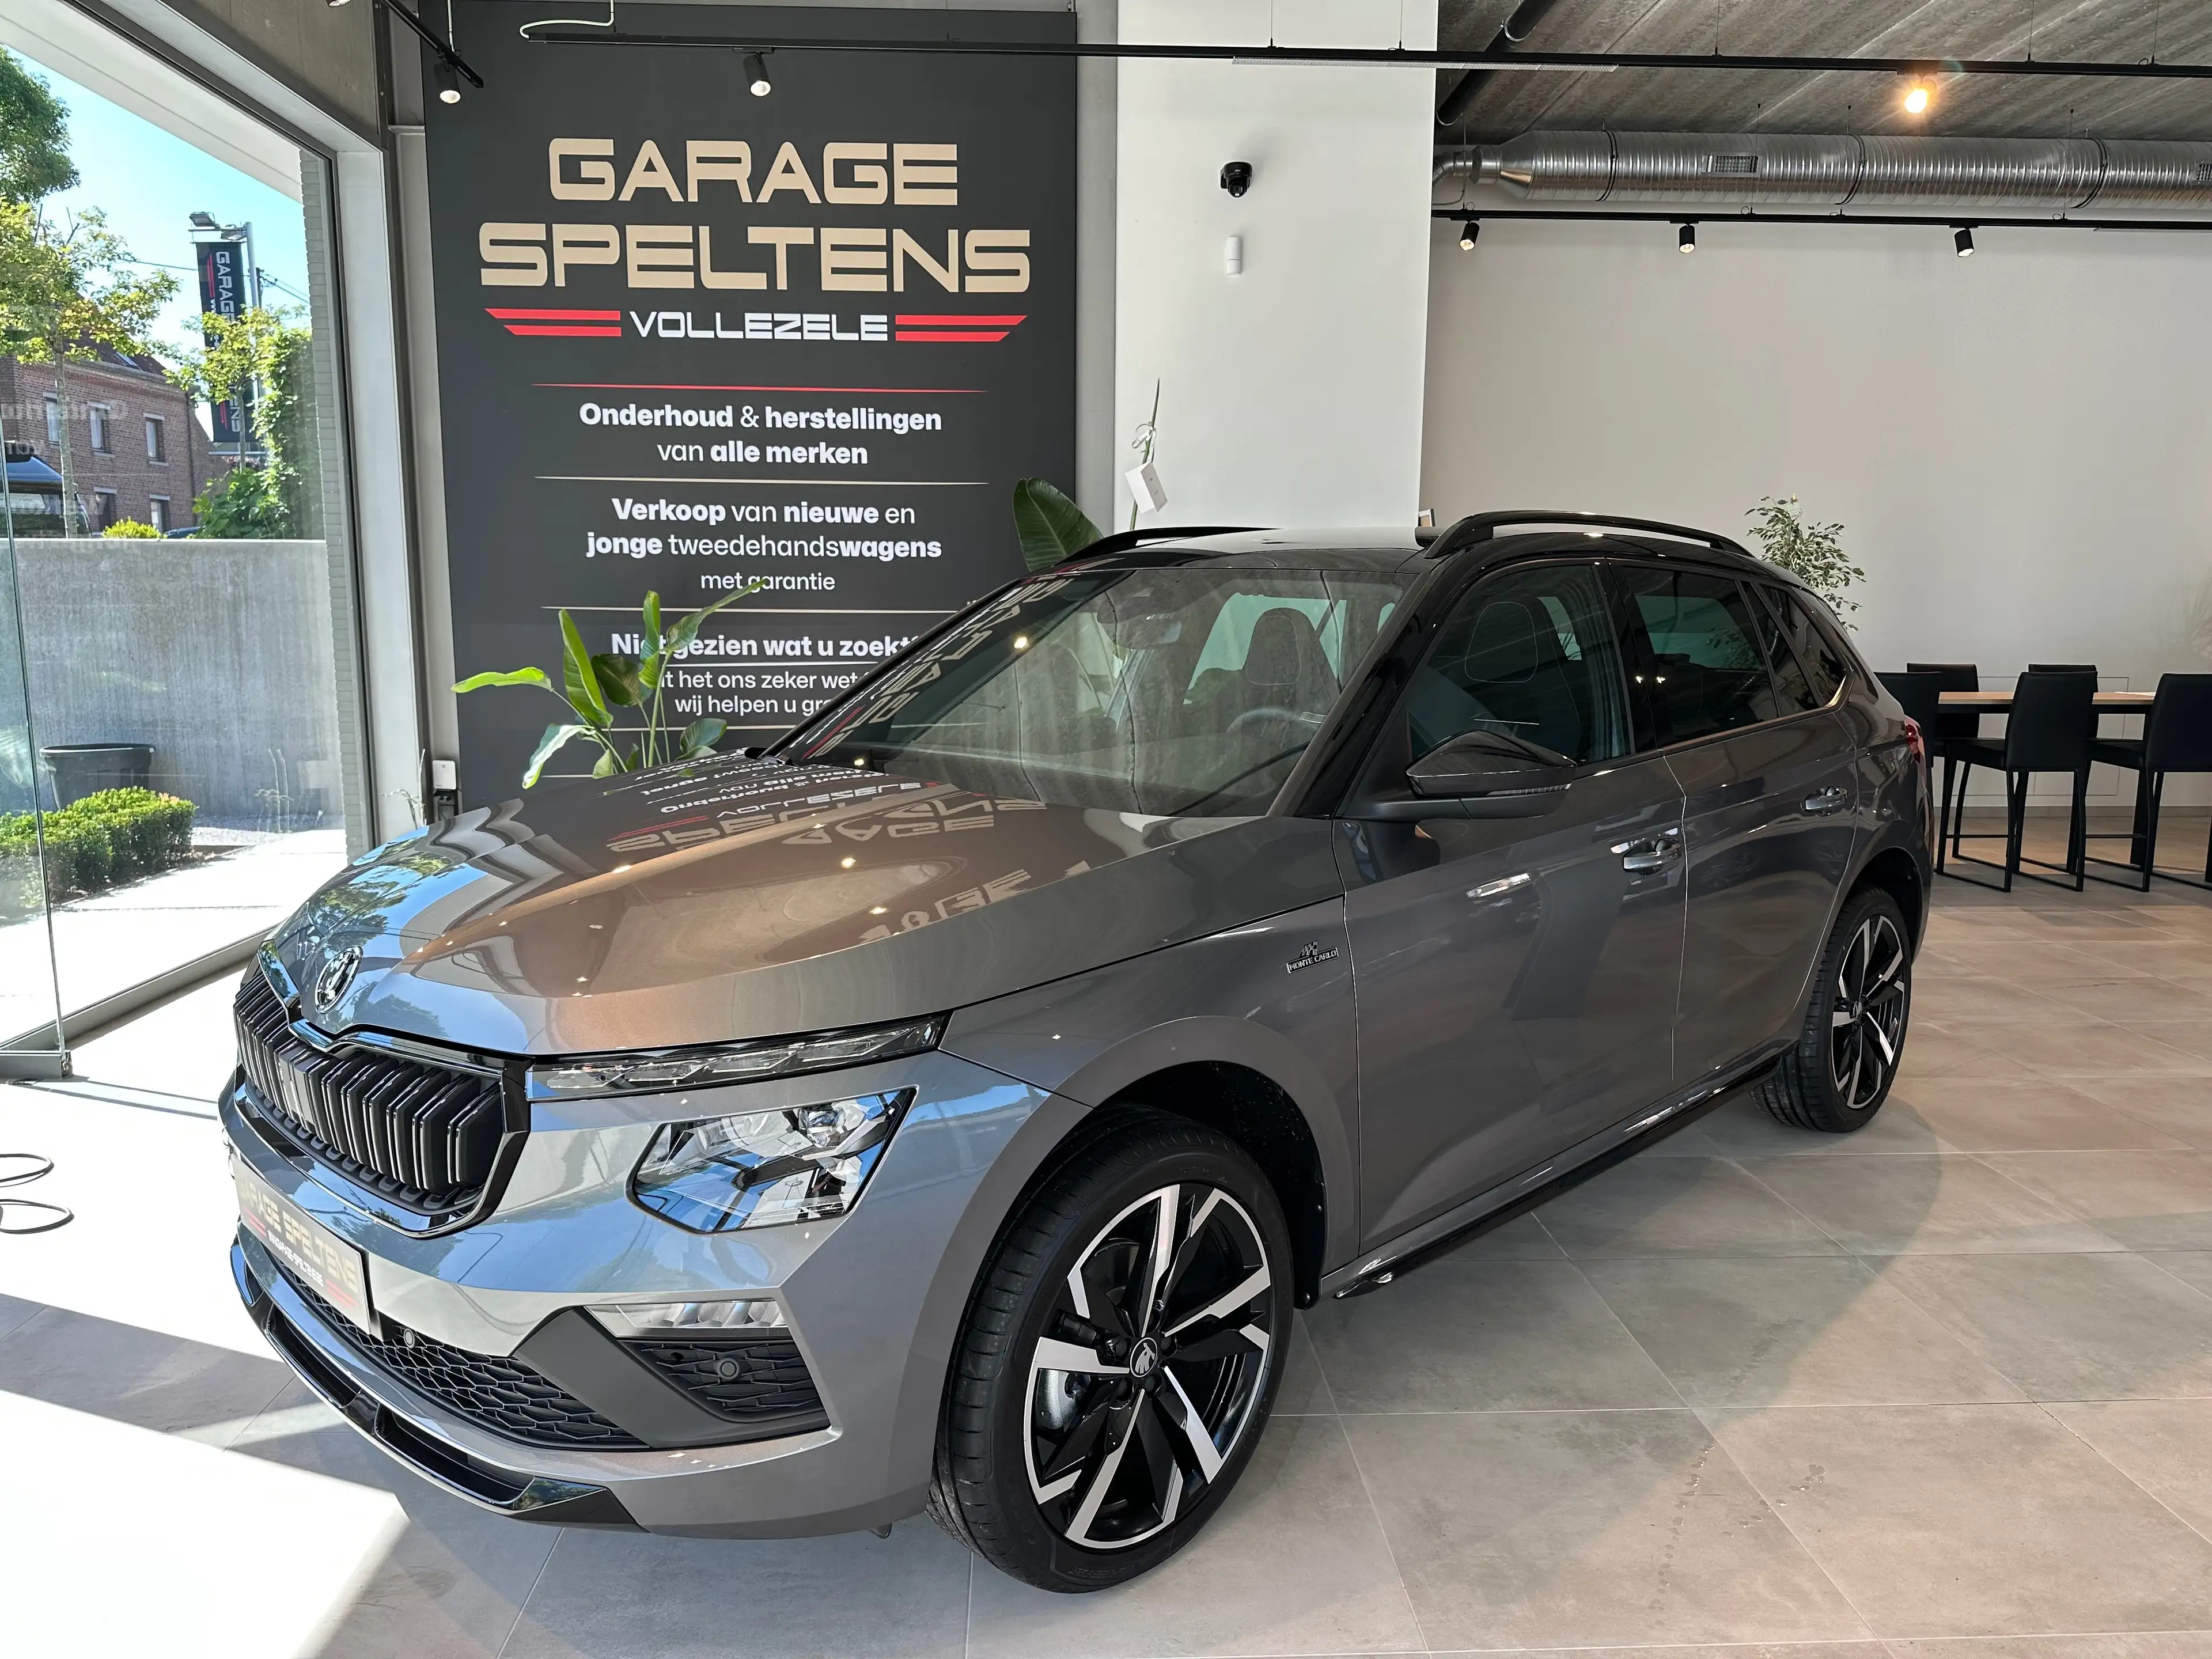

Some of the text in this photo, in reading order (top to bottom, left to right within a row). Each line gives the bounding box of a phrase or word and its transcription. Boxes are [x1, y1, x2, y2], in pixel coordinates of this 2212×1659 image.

[548, 138, 958, 206] GARAGE
[479, 222, 1030, 293] SPELTENS
[629, 310, 888, 342] VOLLEZELE
[579, 403, 942, 435] Onderhoud & herstellingen
[657, 441, 868, 464] van alle merken
[611, 498, 915, 526] Verkoop van nieuwe en
[586, 532, 942, 562] jonge tweedehandswagens
[700, 572, 835, 593] met garantie
[612, 633, 667, 656] Nit
[763, 636, 812, 656] wat
[817, 640, 834, 656] u
[679, 671, 713, 688] het
[717, 675, 756, 688] ons
[761, 671, 817, 689] zeker
[675, 695, 702, 716] wij
[708, 695, 778, 717] helpen
[784, 699, 797, 713] u
[1289, 949, 1337, 971] MONTE CARLO
